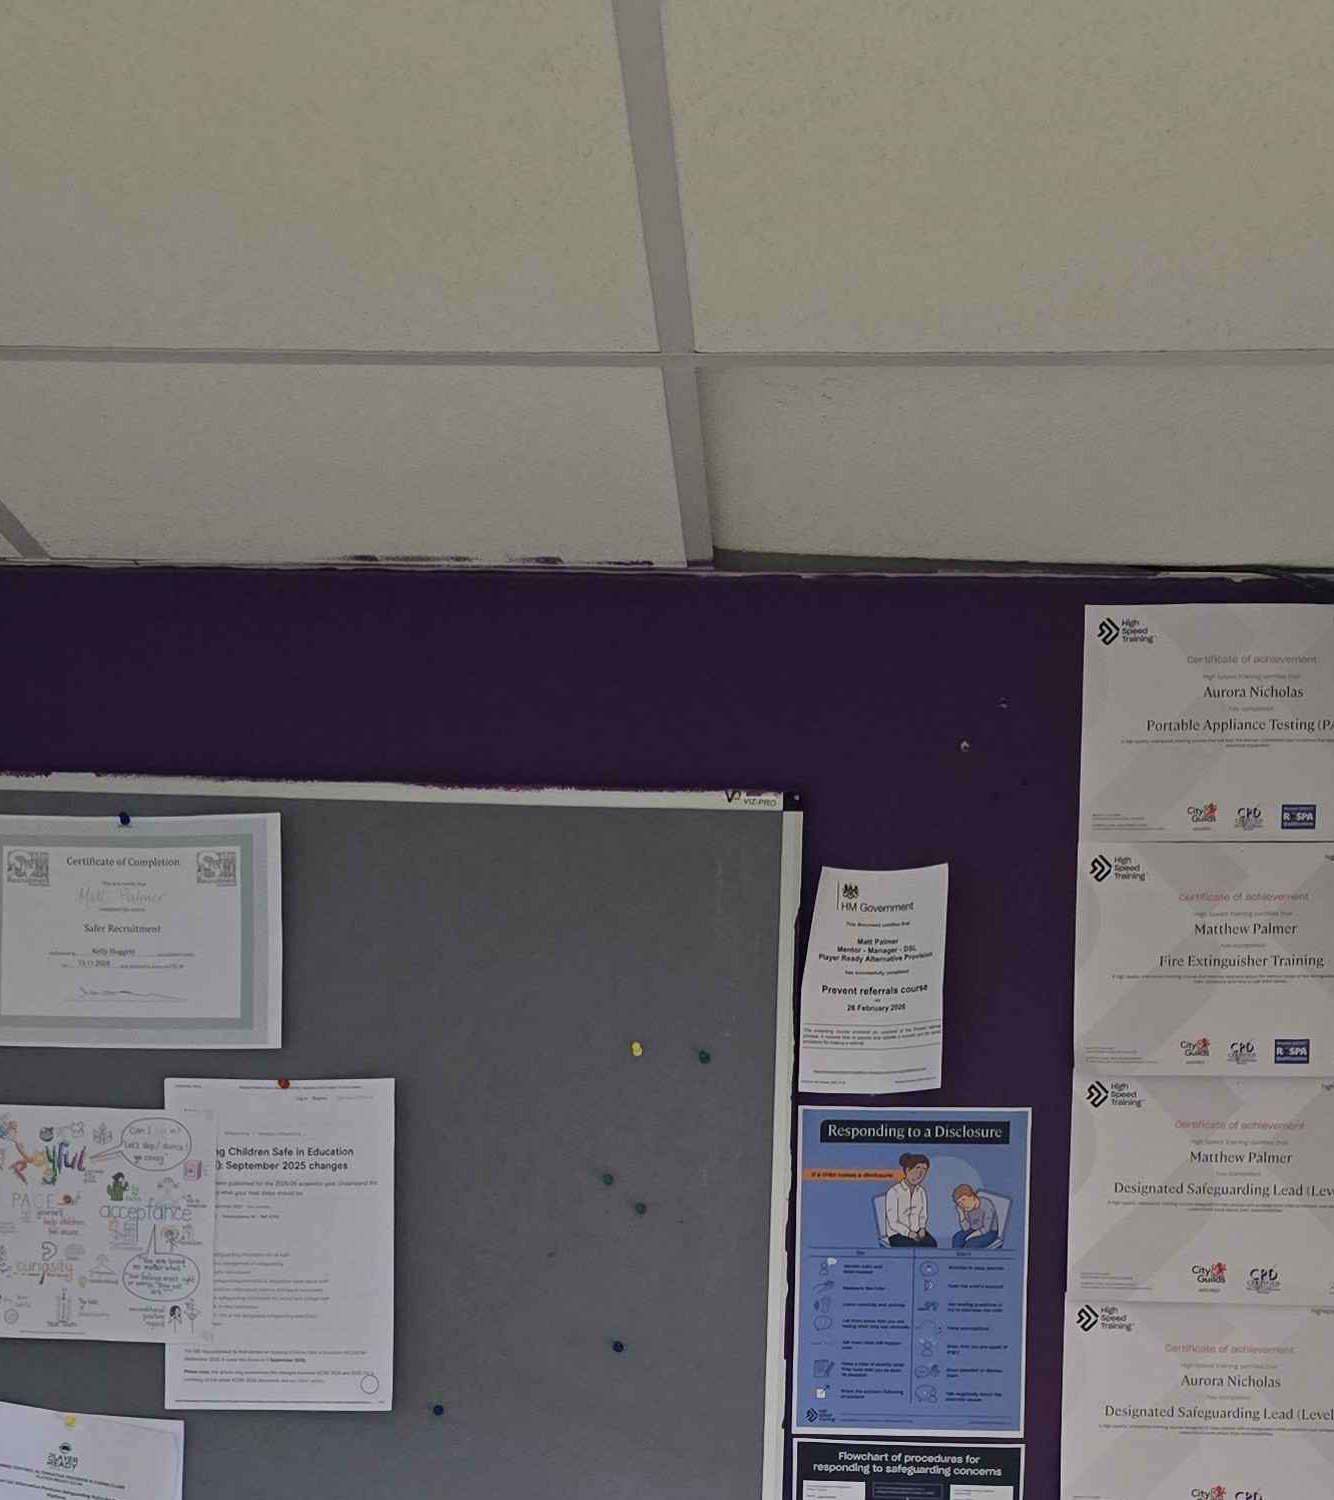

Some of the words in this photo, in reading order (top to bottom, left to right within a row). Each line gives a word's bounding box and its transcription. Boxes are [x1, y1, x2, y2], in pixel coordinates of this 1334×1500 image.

[1122, 619, 1140, 628] High
[1122, 627, 1148, 636] Speed
[1122, 635, 1154, 645] Training
[1203, 686, 1246, 698] Aurora
[1249, 685, 1303, 698] Nicholas
[1147, 719, 1200, 732] Portable
[1202, 719, 1266, 733] Appliance
[1269, 719, 1314, 733] Testing
[66, 856, 115, 868] Certificate
[116, 856, 126, 867] of
[127, 856, 180, 869] Completion
[841, 902, 858, 912] HM
[859, 902, 914, 912] Government
[84, 923, 106, 935] Safer
[107, 923, 161, 935] Recruitment
[1194, 923, 1249, 935] Matthew
[1253, 923, 1298, 935] Palmer
[874, 938, 899, 946] Palmer
[1159, 955, 1184, 967] Fire
[1187, 955, 1268, 969] Extinguisher
[1270, 955, 1324, 969] Training
[821, 984, 858, 996] Prevent
[859, 985, 899, 996] referrals
[900, 984, 928, 995] course
[857, 1004, 889, 1013] February
[828, 1124, 905, 1140] Responding
[907, 1126, 921, 1138] to
[924, 1128, 931, 1138] a
[934, 1125, 1003, 1139] Disclosure
[228, 1147, 270, 1157] Children
[271, 1147, 294, 1157] Safe
[296, 1147, 305, 1157] in
[307, 1147, 354, 1157] Education
[1189, 1151, 1245, 1163] Matthew
[1248, 1152, 1293, 1164] Palmer
[226, 1160, 279, 1172] September
[282, 1161, 307, 1170] 2025
[309, 1160, 348, 1172] changes
[1114, 1182, 1184, 1196] Designated
[1187, 1183, 1270, 1198] Safeguarding
[1273, 1184, 1303, 1196] Lead
[99, 1199, 192, 1222] acceptance
[1180, 1375, 1224, 1387] Aurora
[1227, 1375, 1281, 1388] Nicholas
[1104, 1404, 1175, 1420] Designated
[1177, 1406, 1261, 1422] Safeguarding
[1263, 1408, 1294, 1420] Lead
[1297, 1409, 1334, 1422] (Level
[838, 1451, 889, 1462] Flowchart
[891, 1452, 903, 1462] of
[904, 1453, 963, 1466] procedures
[965, 1454, 981, 1464] for
[813, 1463, 870, 1477] responding
[872, 1465, 884, 1474] to
[885, 1464, 951, 1477] safeguarding
[953, 1468, 1002, 1477] concerns
